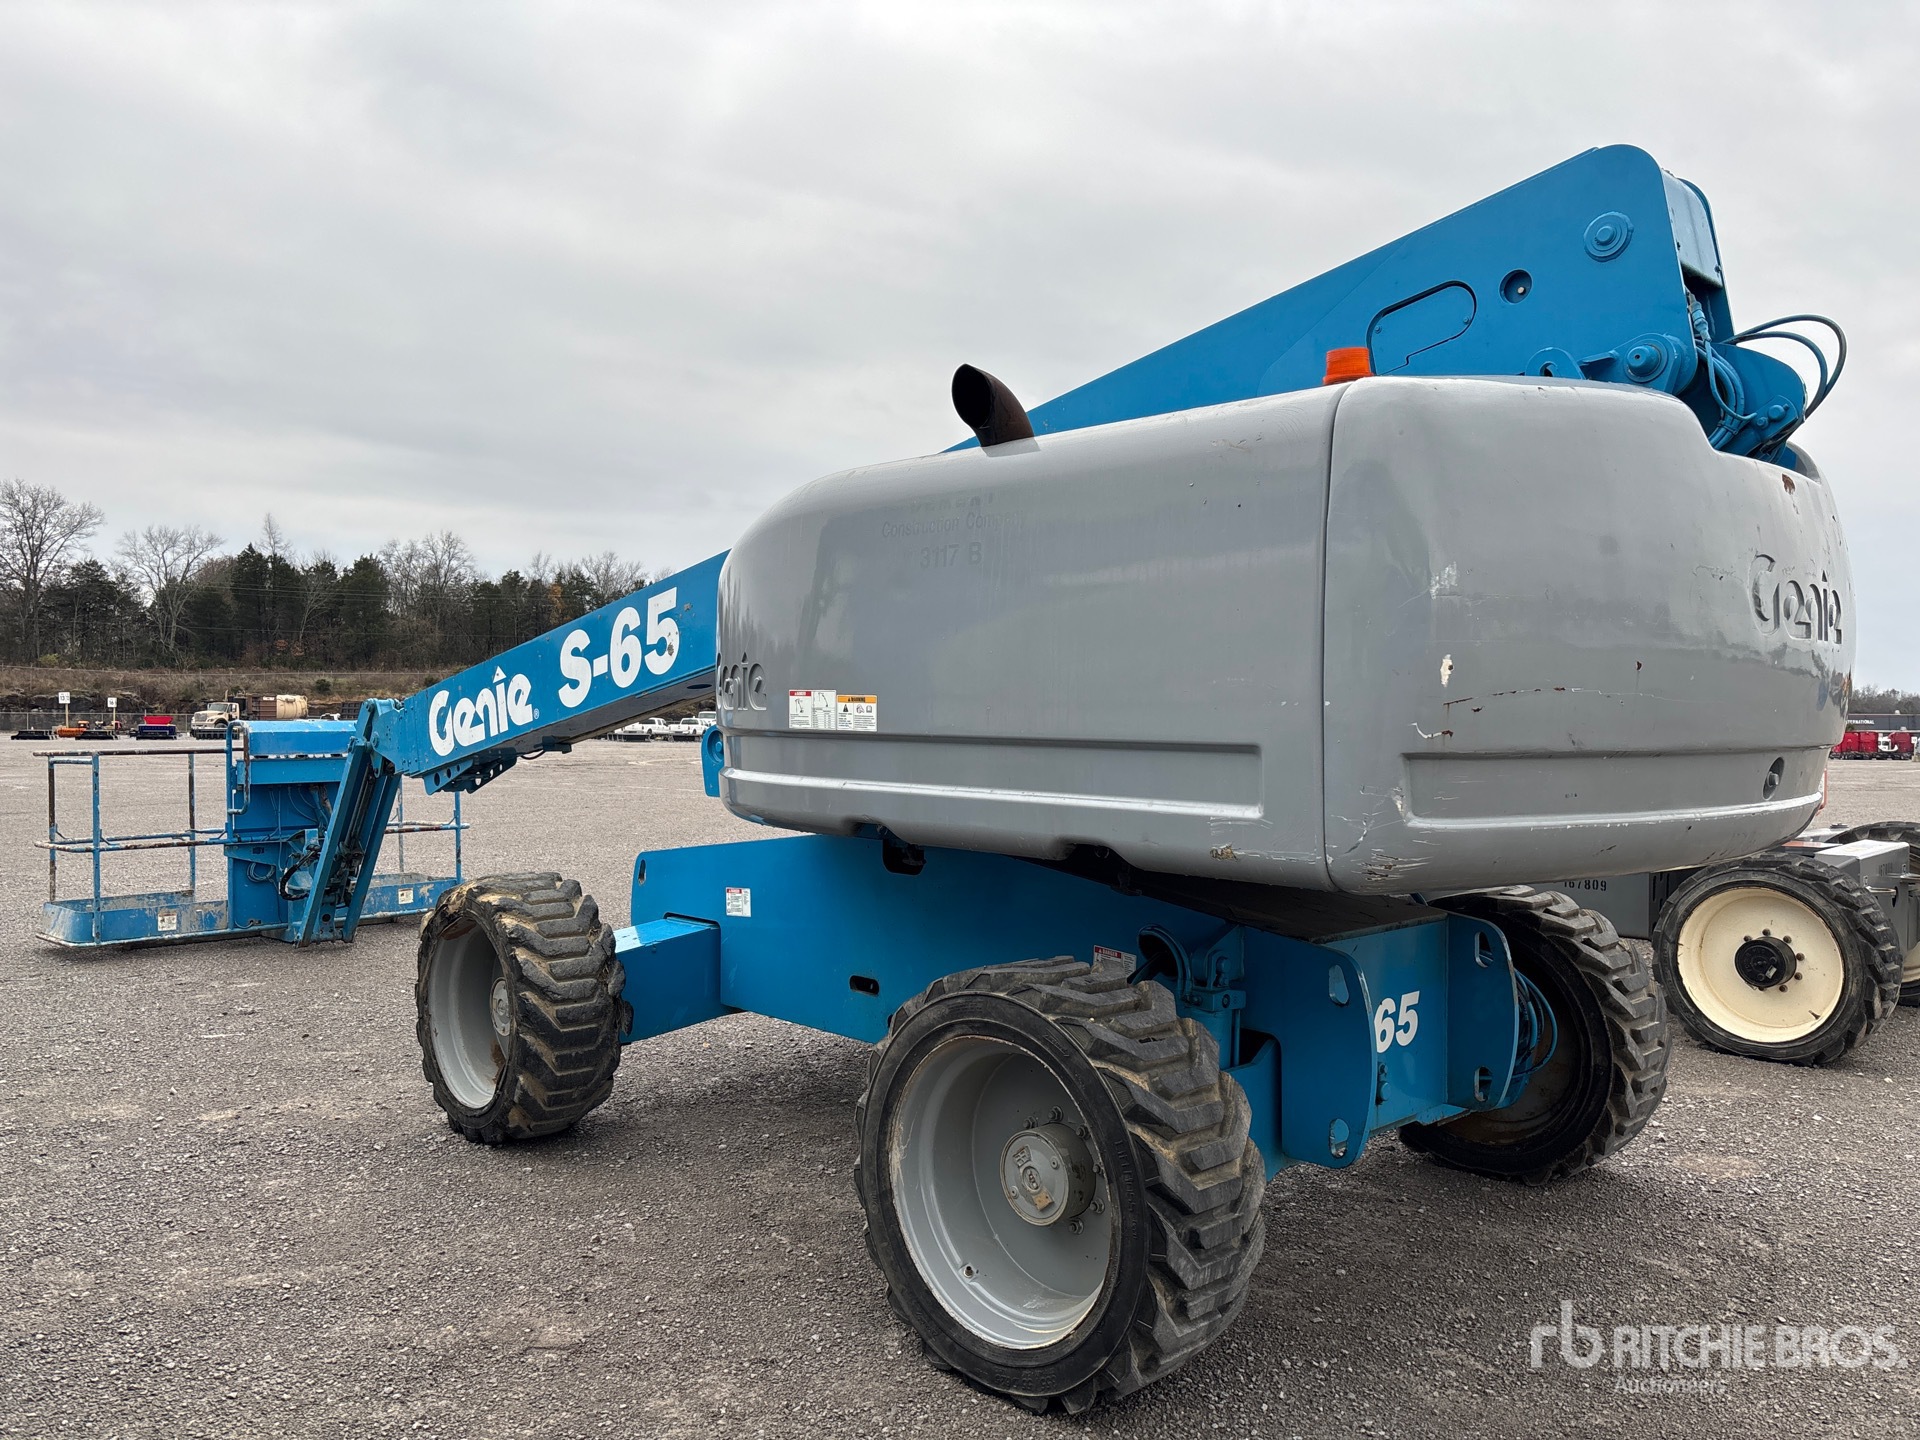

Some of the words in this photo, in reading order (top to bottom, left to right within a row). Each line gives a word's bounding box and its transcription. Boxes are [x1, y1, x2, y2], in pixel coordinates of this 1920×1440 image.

[881, 516, 961, 538] Construction
[920, 543, 960, 570] 3117
[968, 541, 983, 566] B
[558, 587, 680, 708] S-65
[428, 665, 534, 757] Genie
[1374, 990, 1420, 1053] 65
